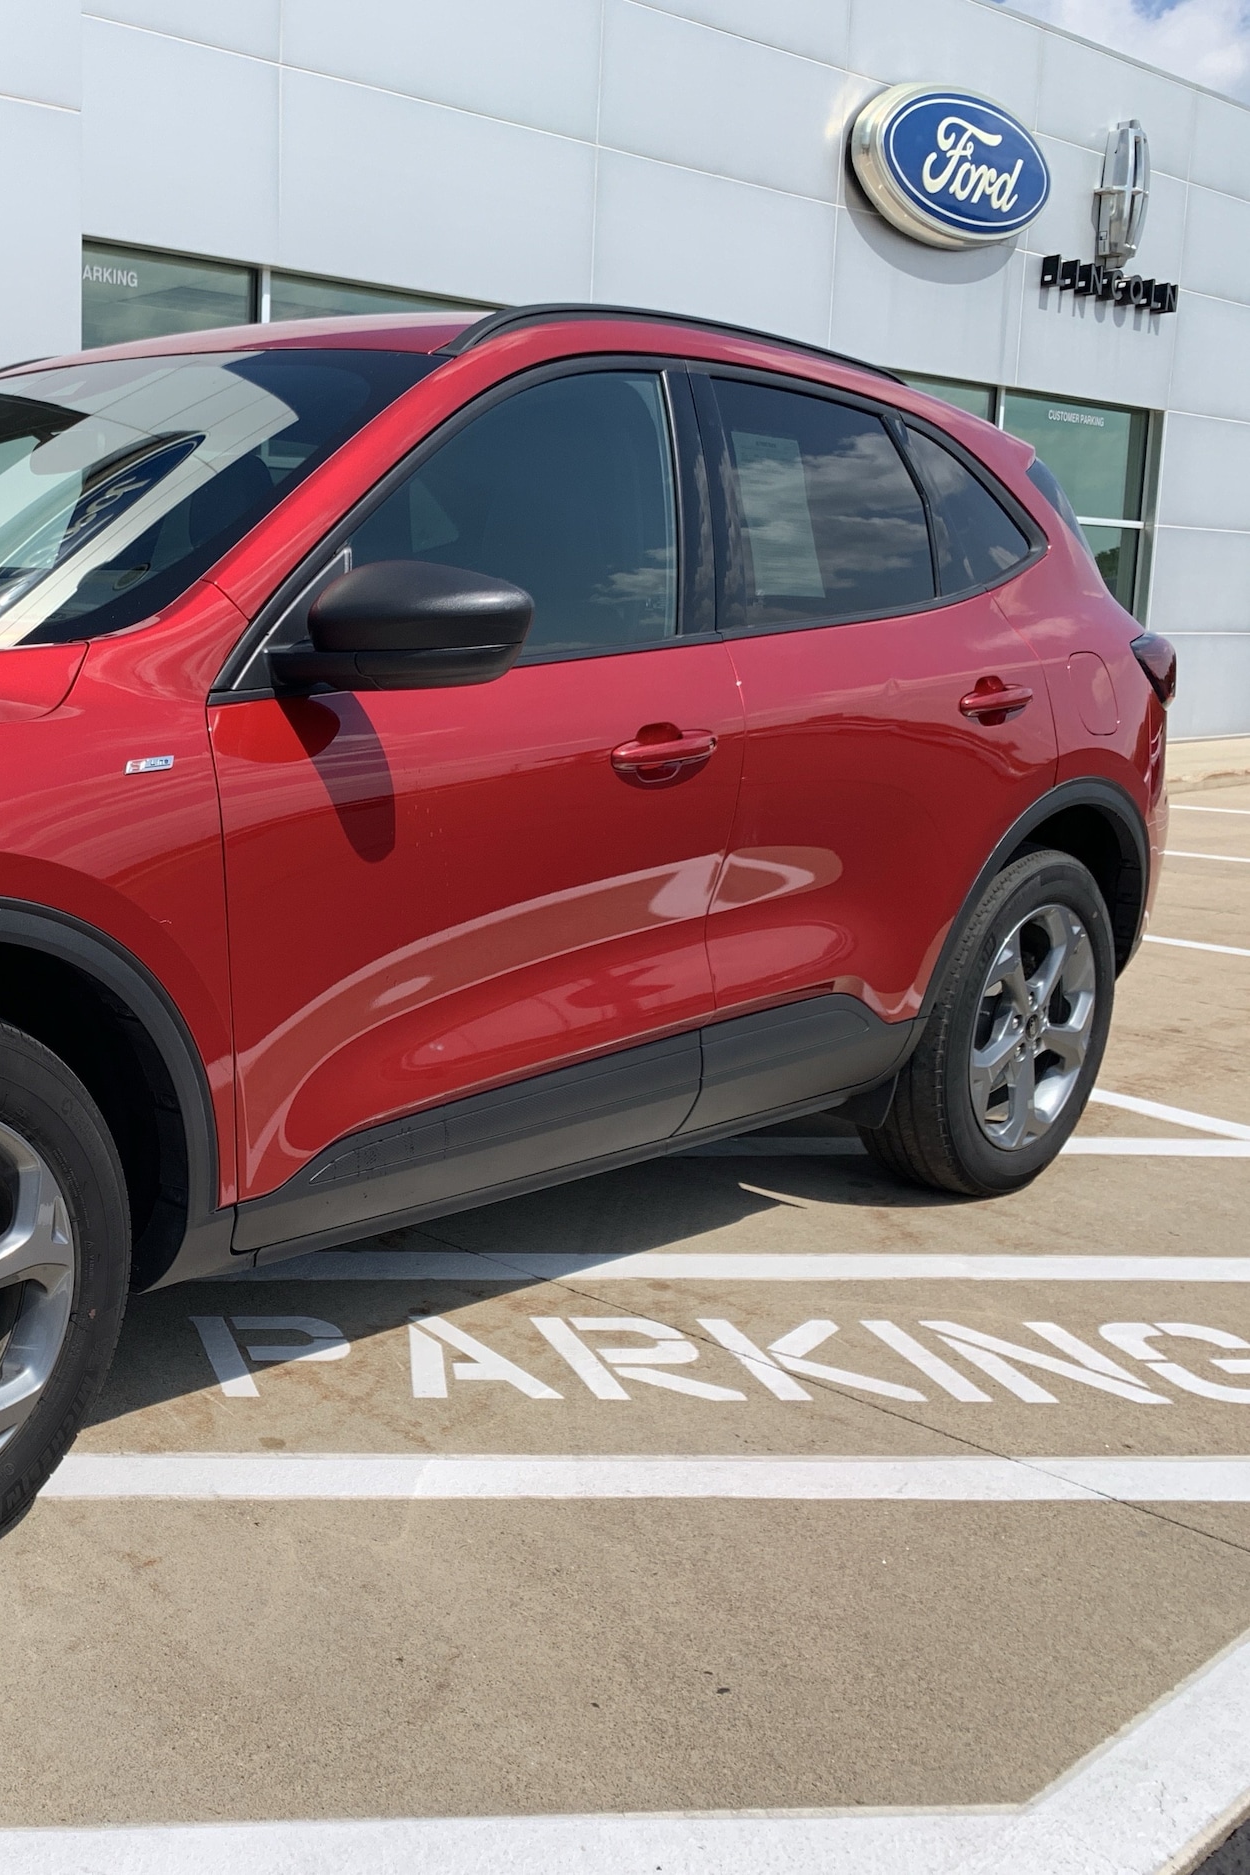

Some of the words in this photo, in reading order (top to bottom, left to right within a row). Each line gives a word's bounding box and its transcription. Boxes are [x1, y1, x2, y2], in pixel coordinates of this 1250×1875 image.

[922, 117, 1023, 213] Ford
[82, 264, 138, 288] ARKING
[1040, 254, 1179, 313] LINCOLN
[1048, 409, 1080, 423] CUSTOMER
[1080, 414, 1104, 427] PARKING
[188, 1316, 1250, 1405] PARKING
